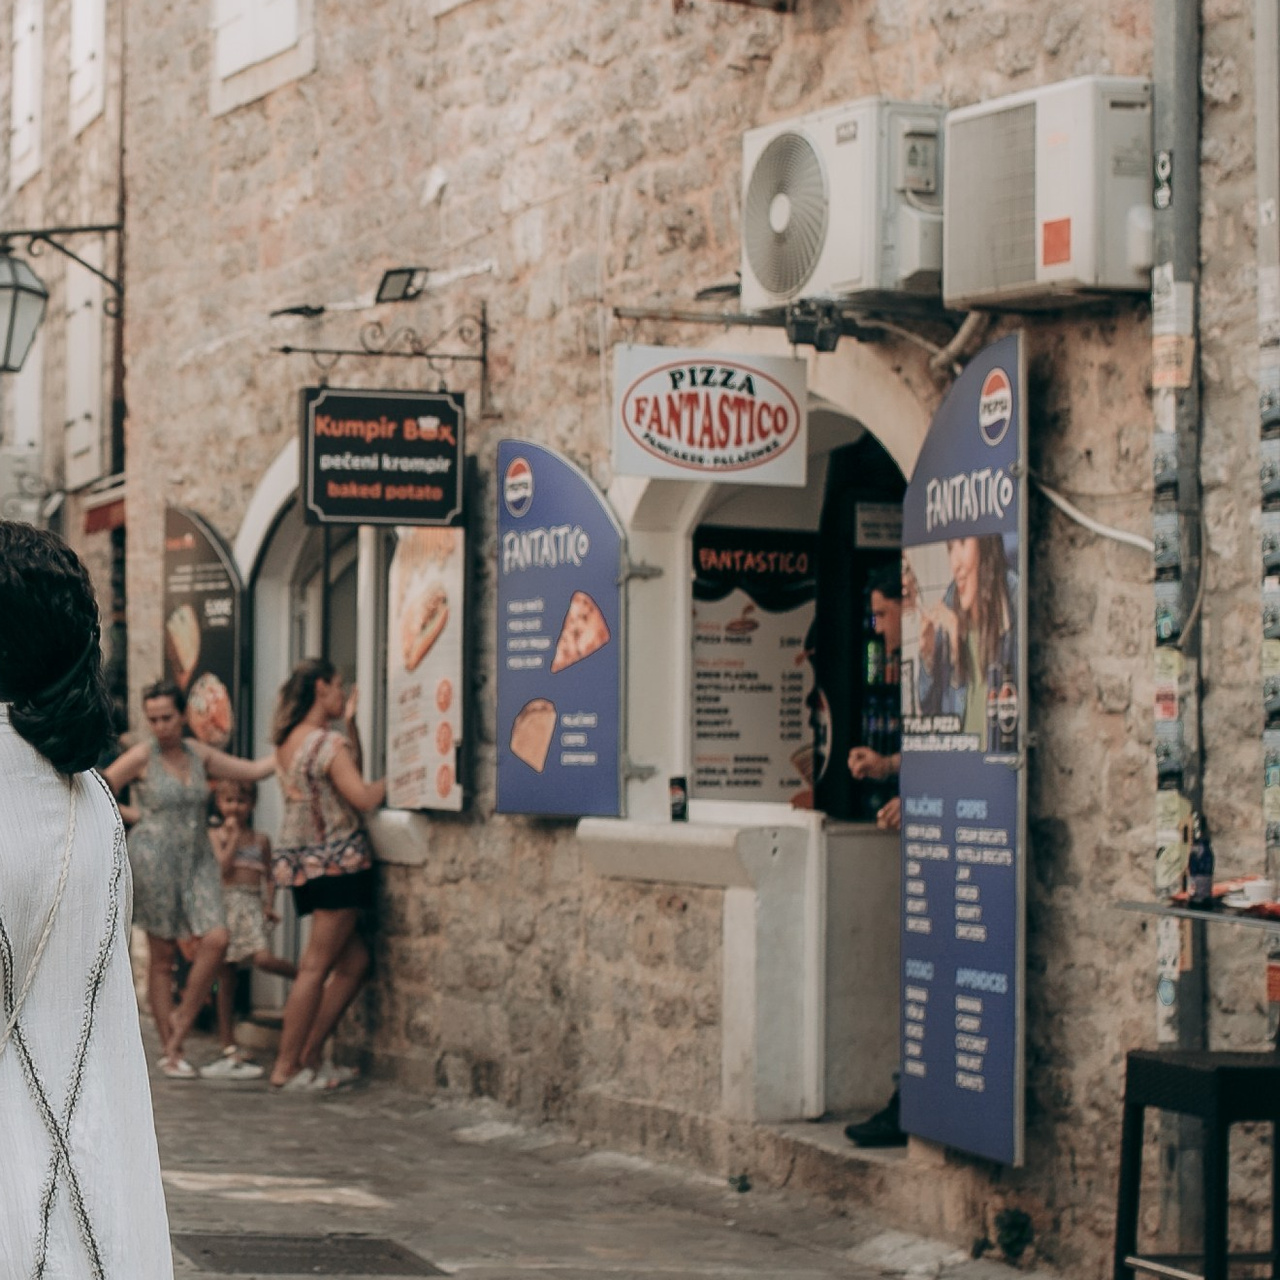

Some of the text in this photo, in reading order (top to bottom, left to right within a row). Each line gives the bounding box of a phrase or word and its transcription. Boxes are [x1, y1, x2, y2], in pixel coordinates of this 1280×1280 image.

[670, 366, 755, 395] PIZZA
[315, 415, 397, 443] Kumpir
[634, 391, 788, 449] FANTASTICO
[382, 453, 451, 474] krompir
[327, 480, 444, 501] baked potato
[926, 468, 1014, 533] FANTASTICO
[504, 525, 590, 574] FANTASTICO
[699, 547, 808, 574] FANTASTICO
